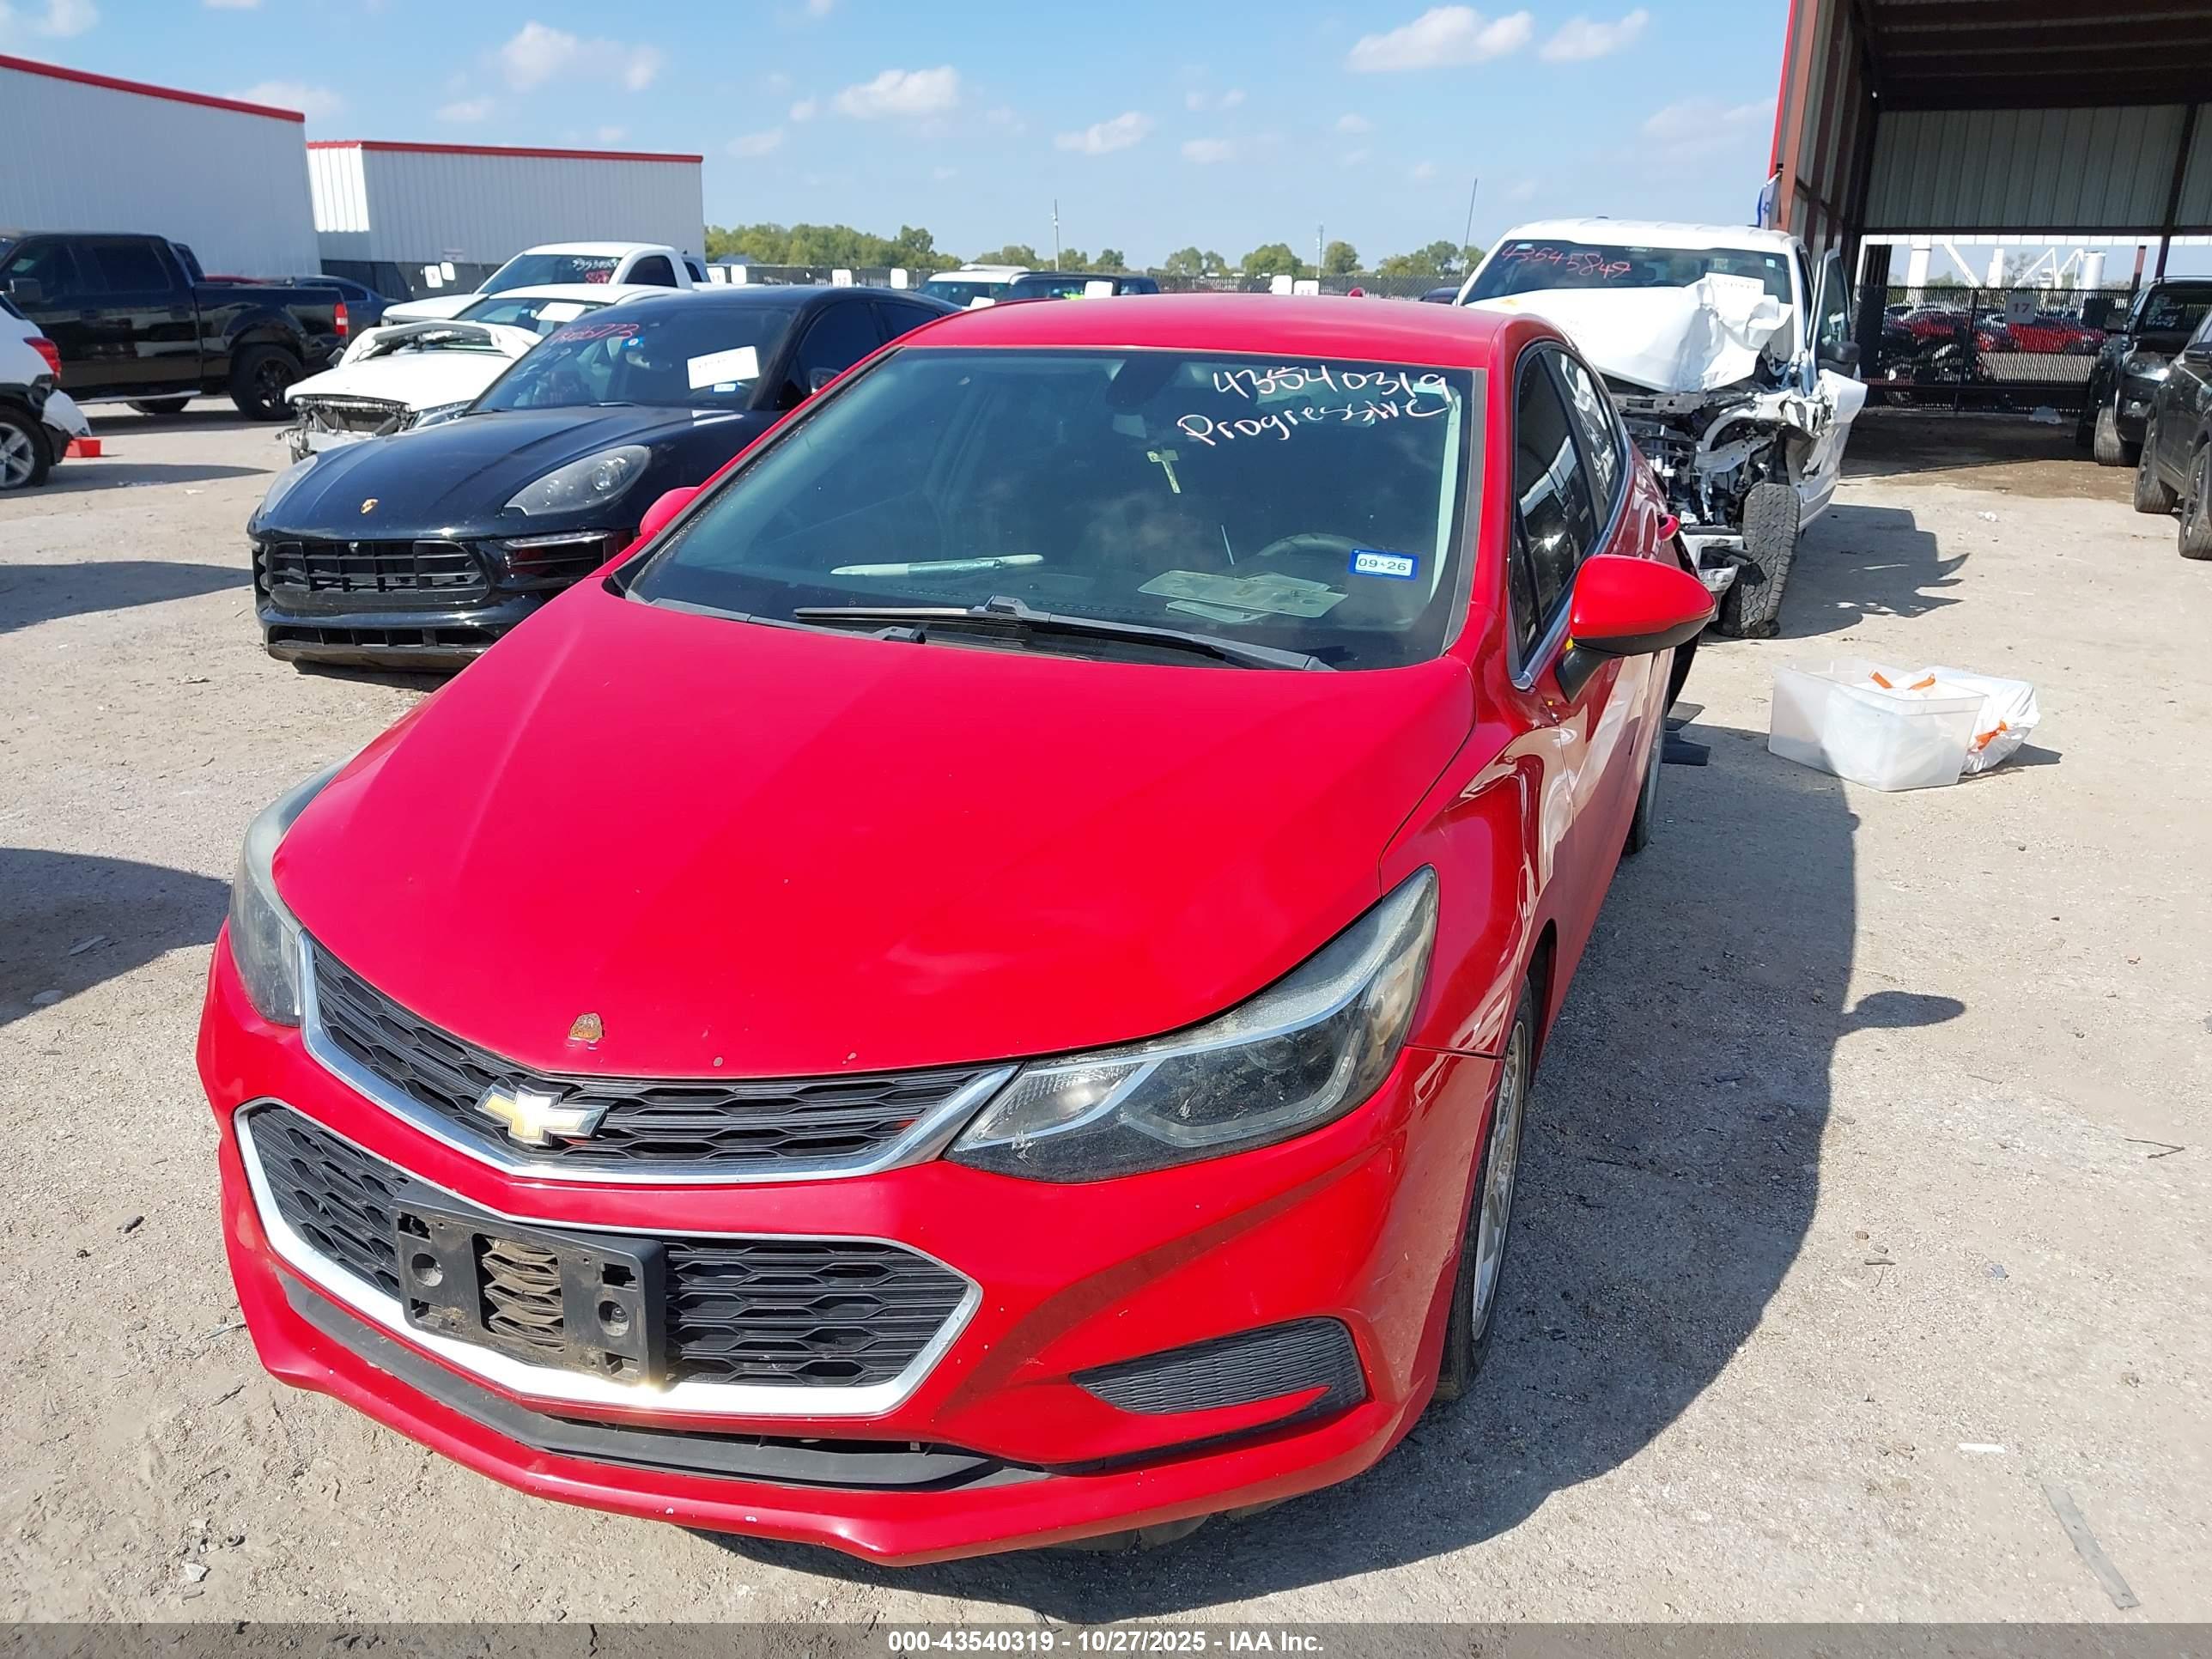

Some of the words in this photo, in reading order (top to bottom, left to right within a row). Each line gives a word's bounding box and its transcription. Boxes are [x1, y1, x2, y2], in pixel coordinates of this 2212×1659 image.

[1501, 243, 1632, 279] 43545849
[2012, 301, 2031, 313] 17
[1212, 365, 1454, 402] 43540319
[1176, 398, 1449, 447] Progressive
